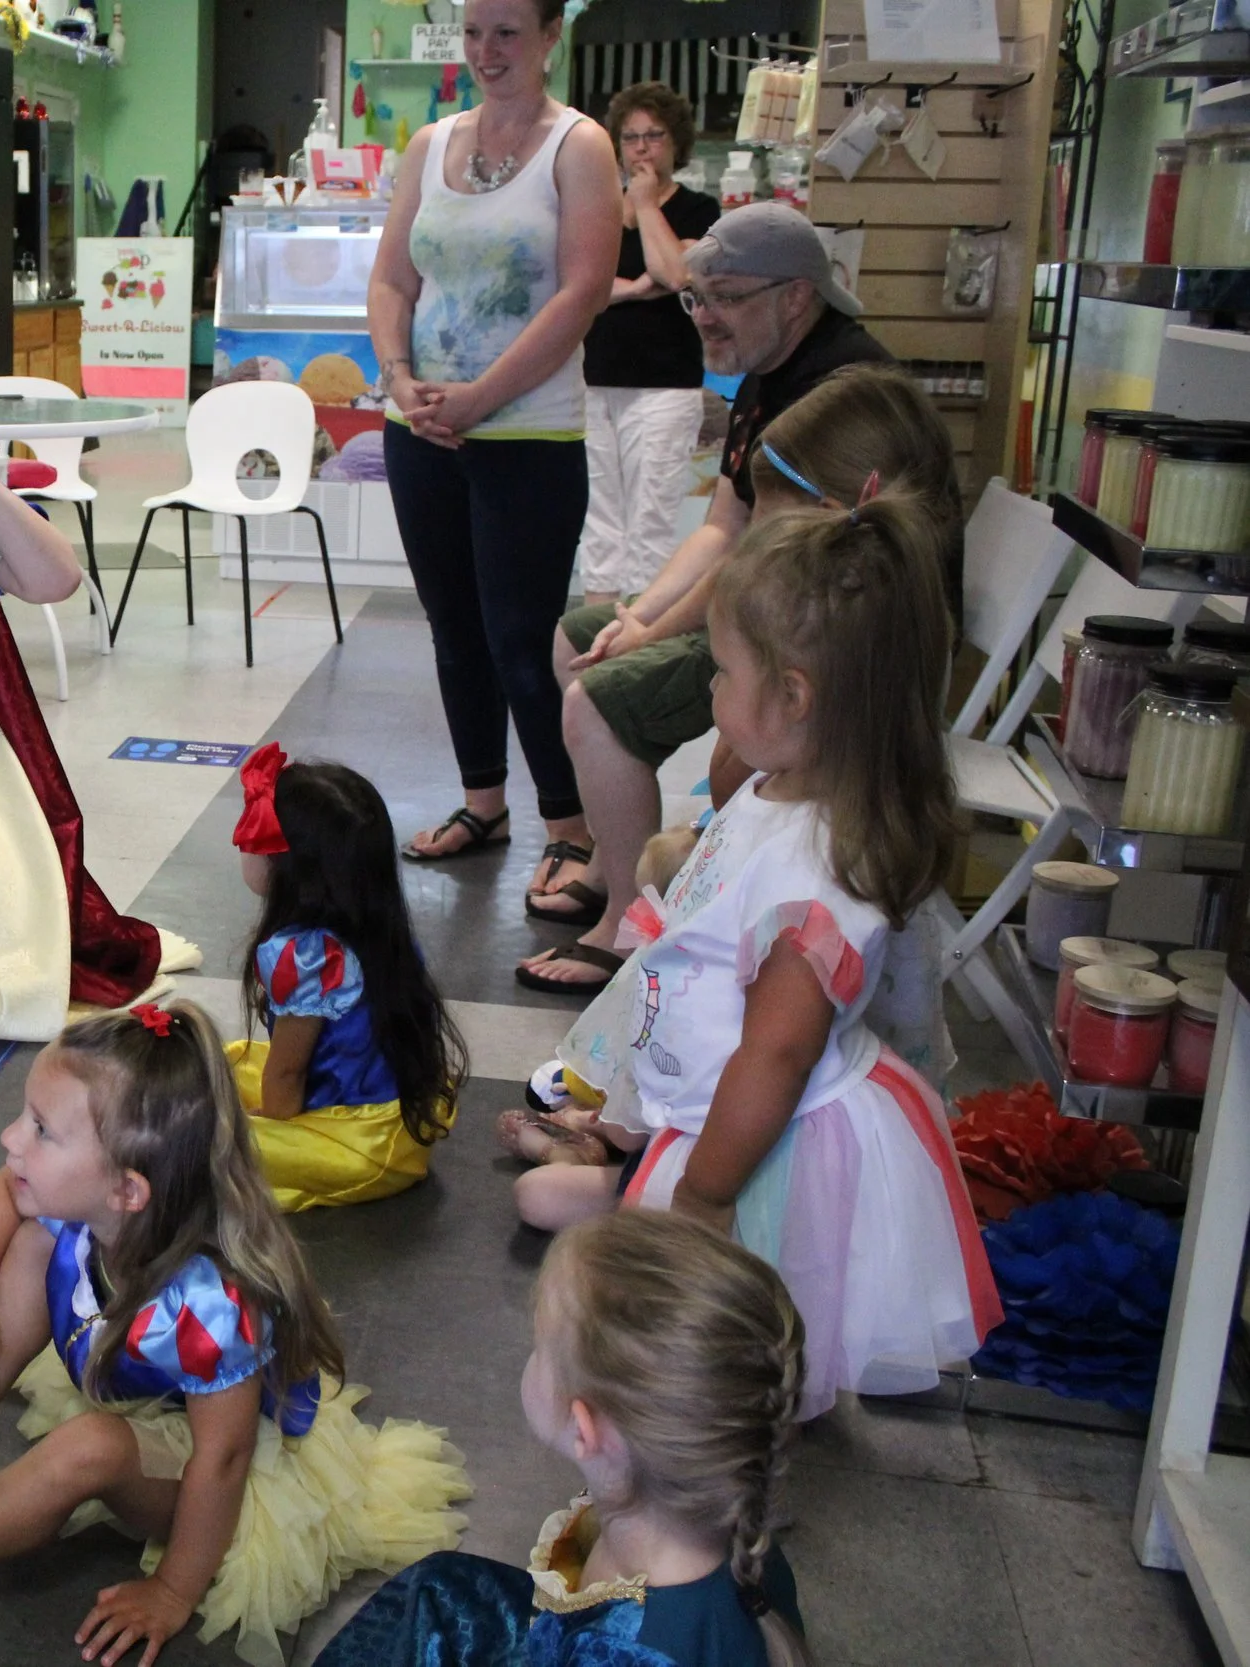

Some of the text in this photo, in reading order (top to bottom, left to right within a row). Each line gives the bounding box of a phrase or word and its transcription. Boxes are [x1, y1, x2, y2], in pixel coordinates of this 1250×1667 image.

[415, 25, 463, 37] PLEASE
[428, 37, 451, 48] PAY
[422, 49, 456, 60] HERE
[99, 349, 164, 362] Is Now Open
